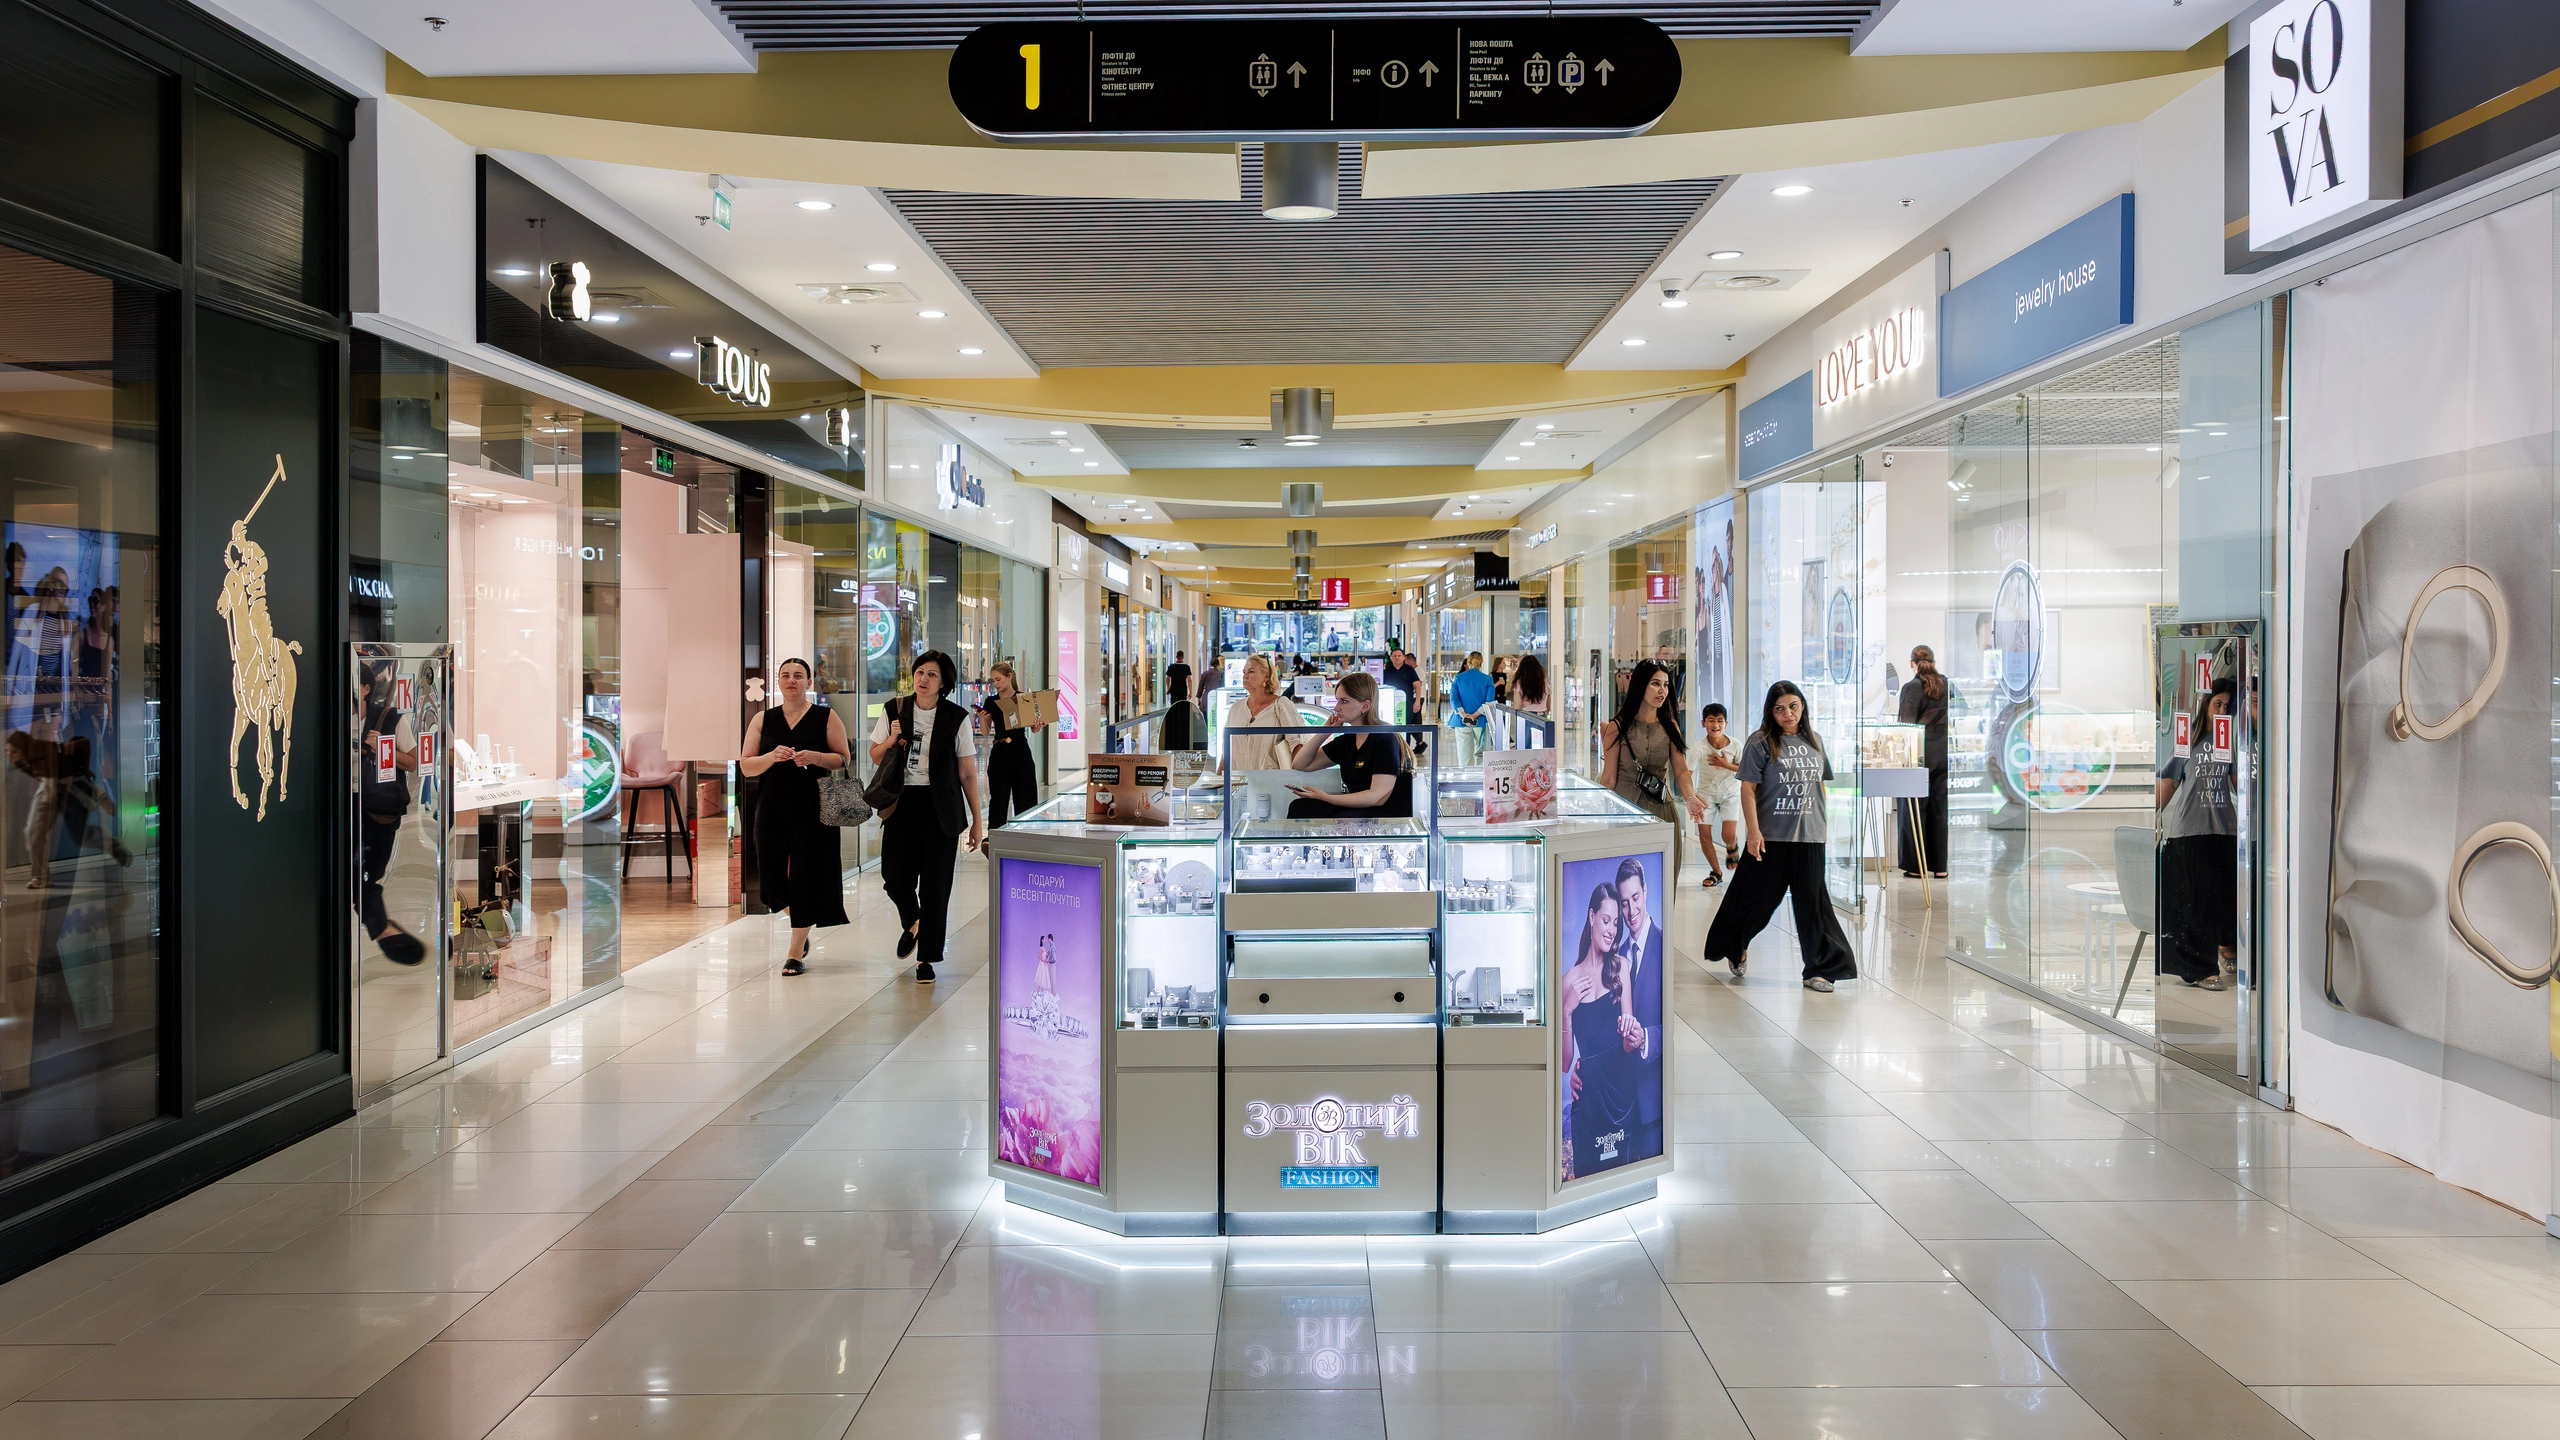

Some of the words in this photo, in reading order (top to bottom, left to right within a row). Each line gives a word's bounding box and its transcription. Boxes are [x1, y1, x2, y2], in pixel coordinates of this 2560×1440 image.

[1470, 57, 1492, 65] ЛІФТИ
[1494, 57, 1504, 65] ДО
[2270, 0, 2344, 120] SO
[1019, 44, 1040, 110] 1
[1129, 83, 1155, 91] ЦЕНТРУ
[2267, 104, 2346, 207] VA
[2014, 278, 2056, 324] jewelry
[2058, 260, 2096, 296] house
[1818, 335, 1864, 408] LOVE
[1870, 308, 1914, 381] YOU
[712, 335, 771, 408] TOUS
[397, 679, 413, 710] ПК
[1788, 745, 1808, 756] DO
[1779, 757, 1820, 769] WHAT
[1778, 769, 1823, 783] MAKES
[1785, 783, 1813, 796] YOU
[1775, 797, 1816, 810] HAPPY
[1028, 873, 1065, 889] ПОДАРУЙ
[1010, 887, 1044, 902] ВСЕСВІТ
[1045, 891, 1081, 908] ПОЧУТТІВ
[1297, 1130, 1367, 1165] ВІК
[1285, 1170, 1374, 1186] FASHION
